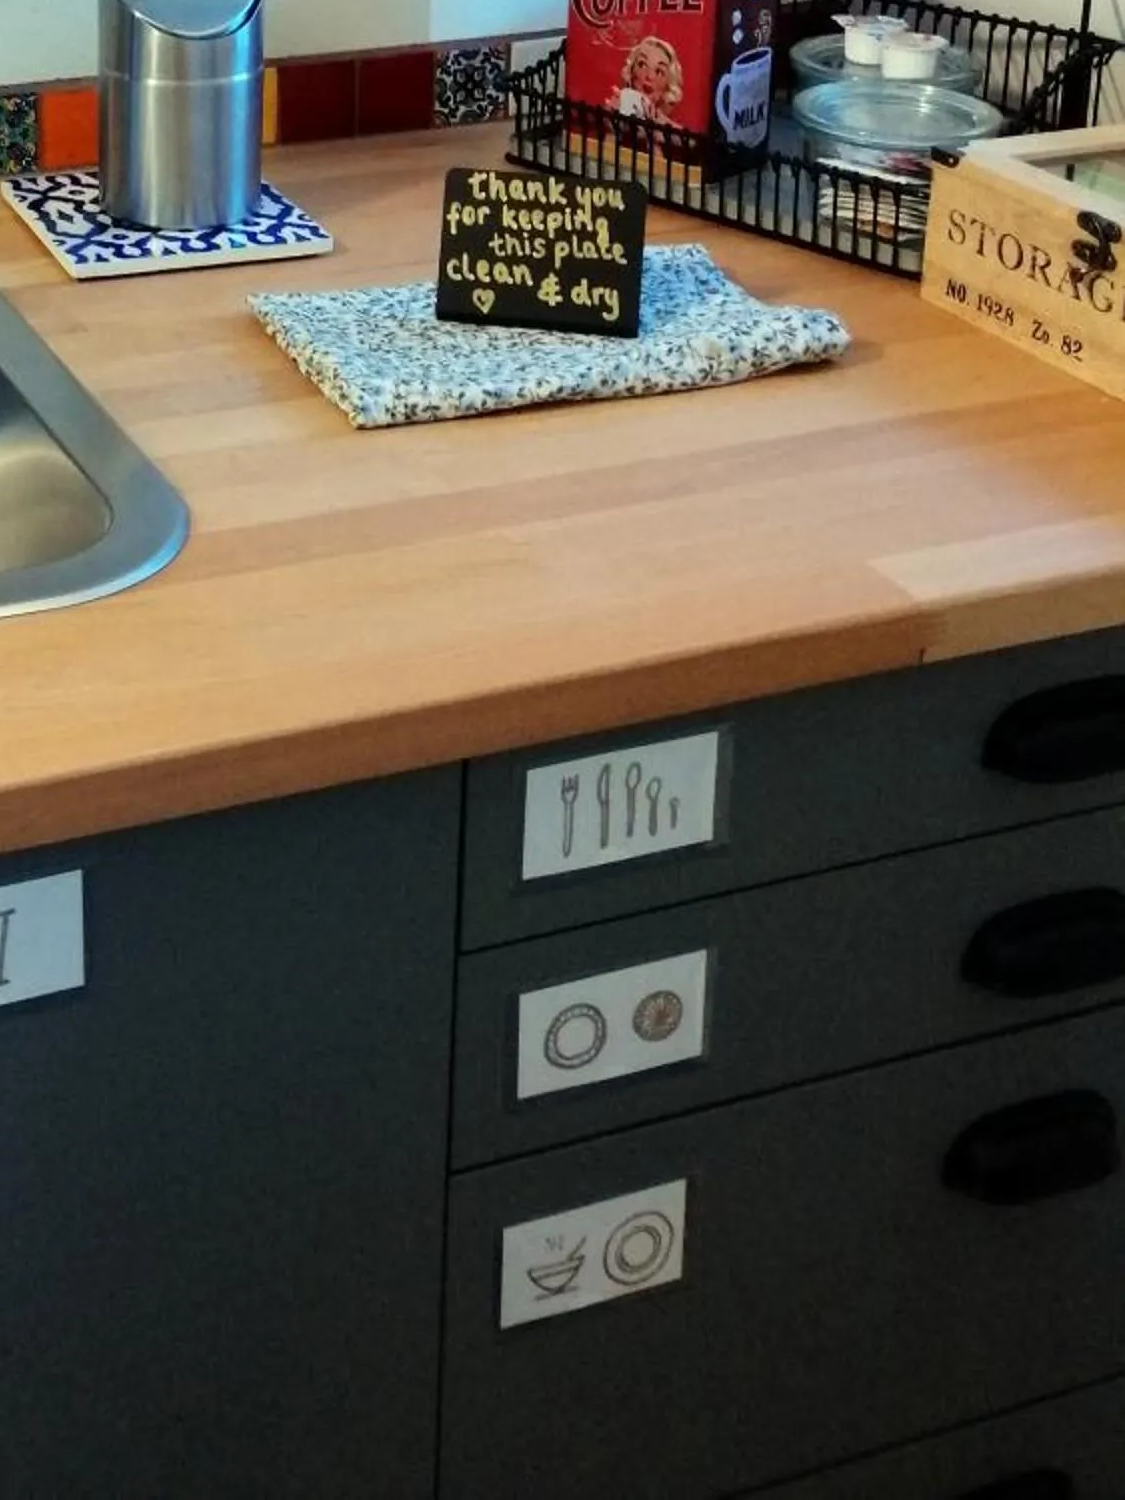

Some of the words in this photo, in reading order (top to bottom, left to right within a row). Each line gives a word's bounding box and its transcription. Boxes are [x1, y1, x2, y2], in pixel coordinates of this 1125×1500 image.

[734, 103, 767, 131] MILK
[576, 186, 625, 211] you
[446, 202, 491, 234] for
[502, 204, 610, 246] keeping
[488, 232, 546, 258] this
[554, 234, 628, 269] plate
[947, 208, 1125, 322] STORAG
[446, 252, 534, 286] clean
[537, 272, 564, 307] &
[570, 278, 620, 321] dry
[976, 293, 1015, 327] 1928
[1060, 334, 1083, 363] 82
